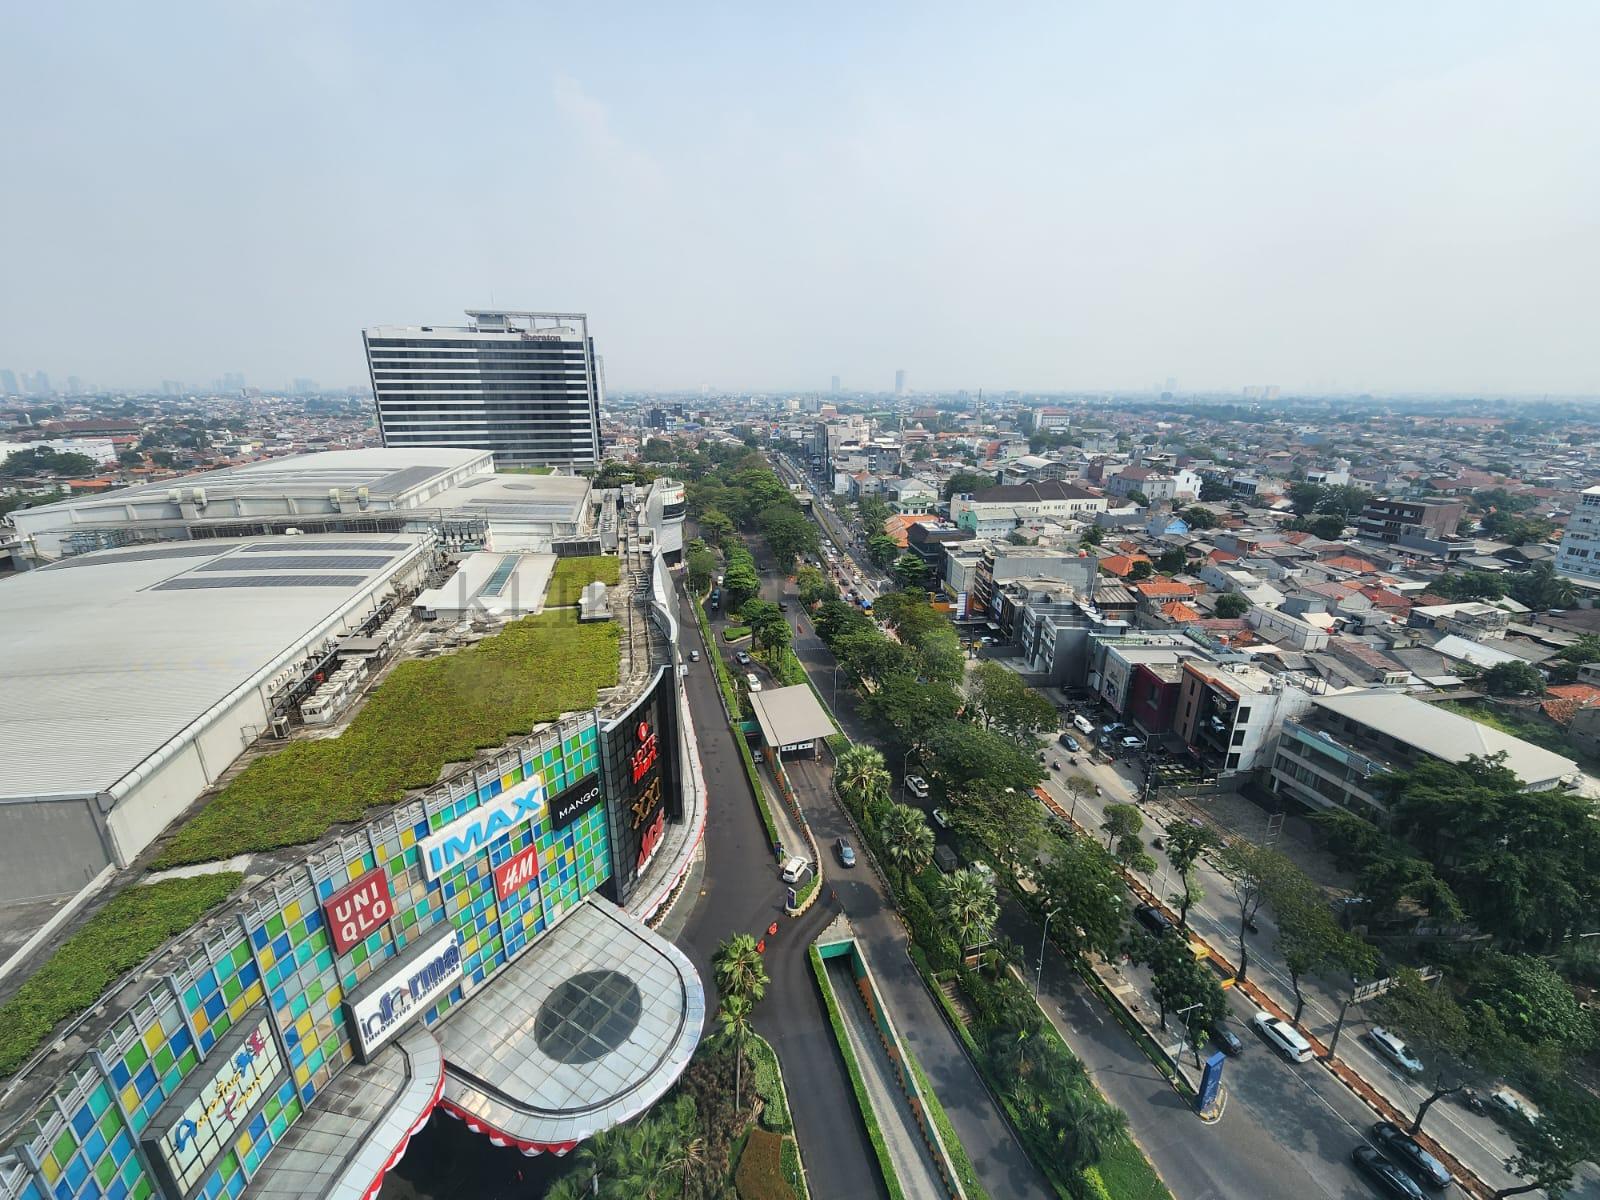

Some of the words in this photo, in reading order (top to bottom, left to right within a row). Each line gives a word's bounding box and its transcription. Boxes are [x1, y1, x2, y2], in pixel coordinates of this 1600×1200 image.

[520, 332, 561, 342] Sheraton
[631, 733, 658, 767] LOTTE
[558, 787, 599, 820] MANGO
[428, 787, 541, 874] IMAX
[502, 851, 535, 895] H&M
[335, 881, 379, 923] UNI
[341, 900, 387, 943] QLO
[360, 944, 460, 1040] informa
[365, 1003, 412, 1046] INNOVATIVE
[412, 963, 461, 1006] FURNISHINGS
